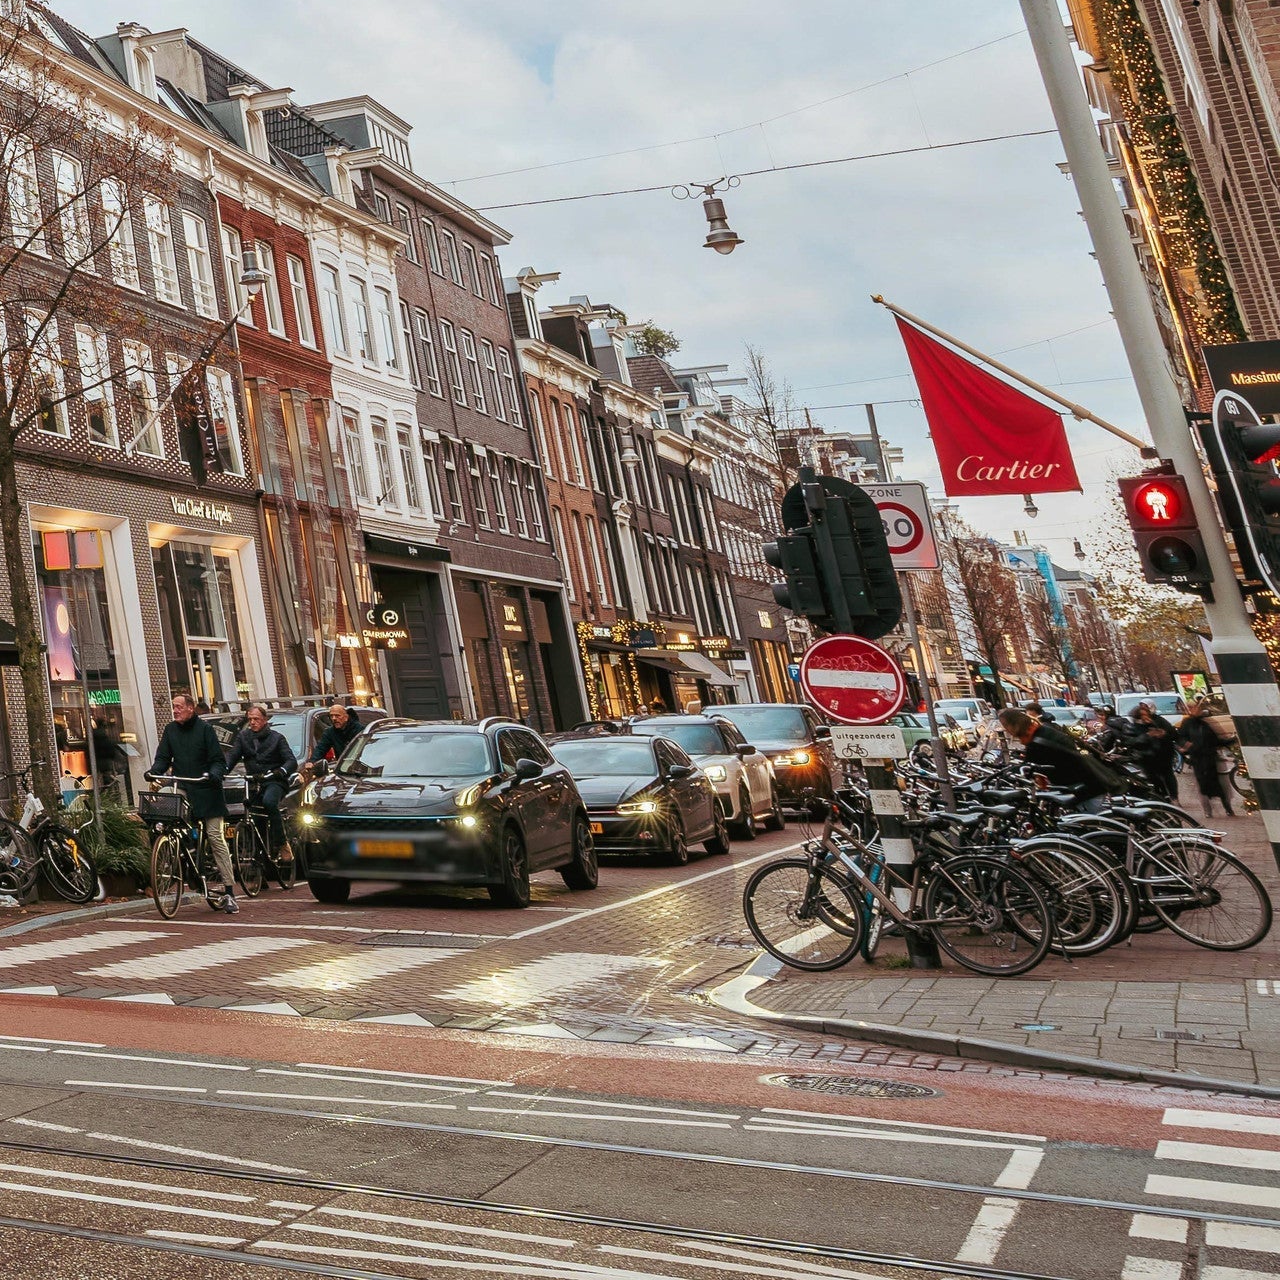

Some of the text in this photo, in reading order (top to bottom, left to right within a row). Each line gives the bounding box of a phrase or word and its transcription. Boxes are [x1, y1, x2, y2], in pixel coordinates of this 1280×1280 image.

[956, 455, 1061, 482] Cartier
[869, 488, 902, 497] ZONE
[171, 496, 187, 516] Van
[186, 499, 205, 518] Cleef
[211, 503, 232, 526] Arpels
[1171, 574, 1188, 582] 331
[375, 630, 408, 639] RIMOWA
[792, 669, 798, 678] P
